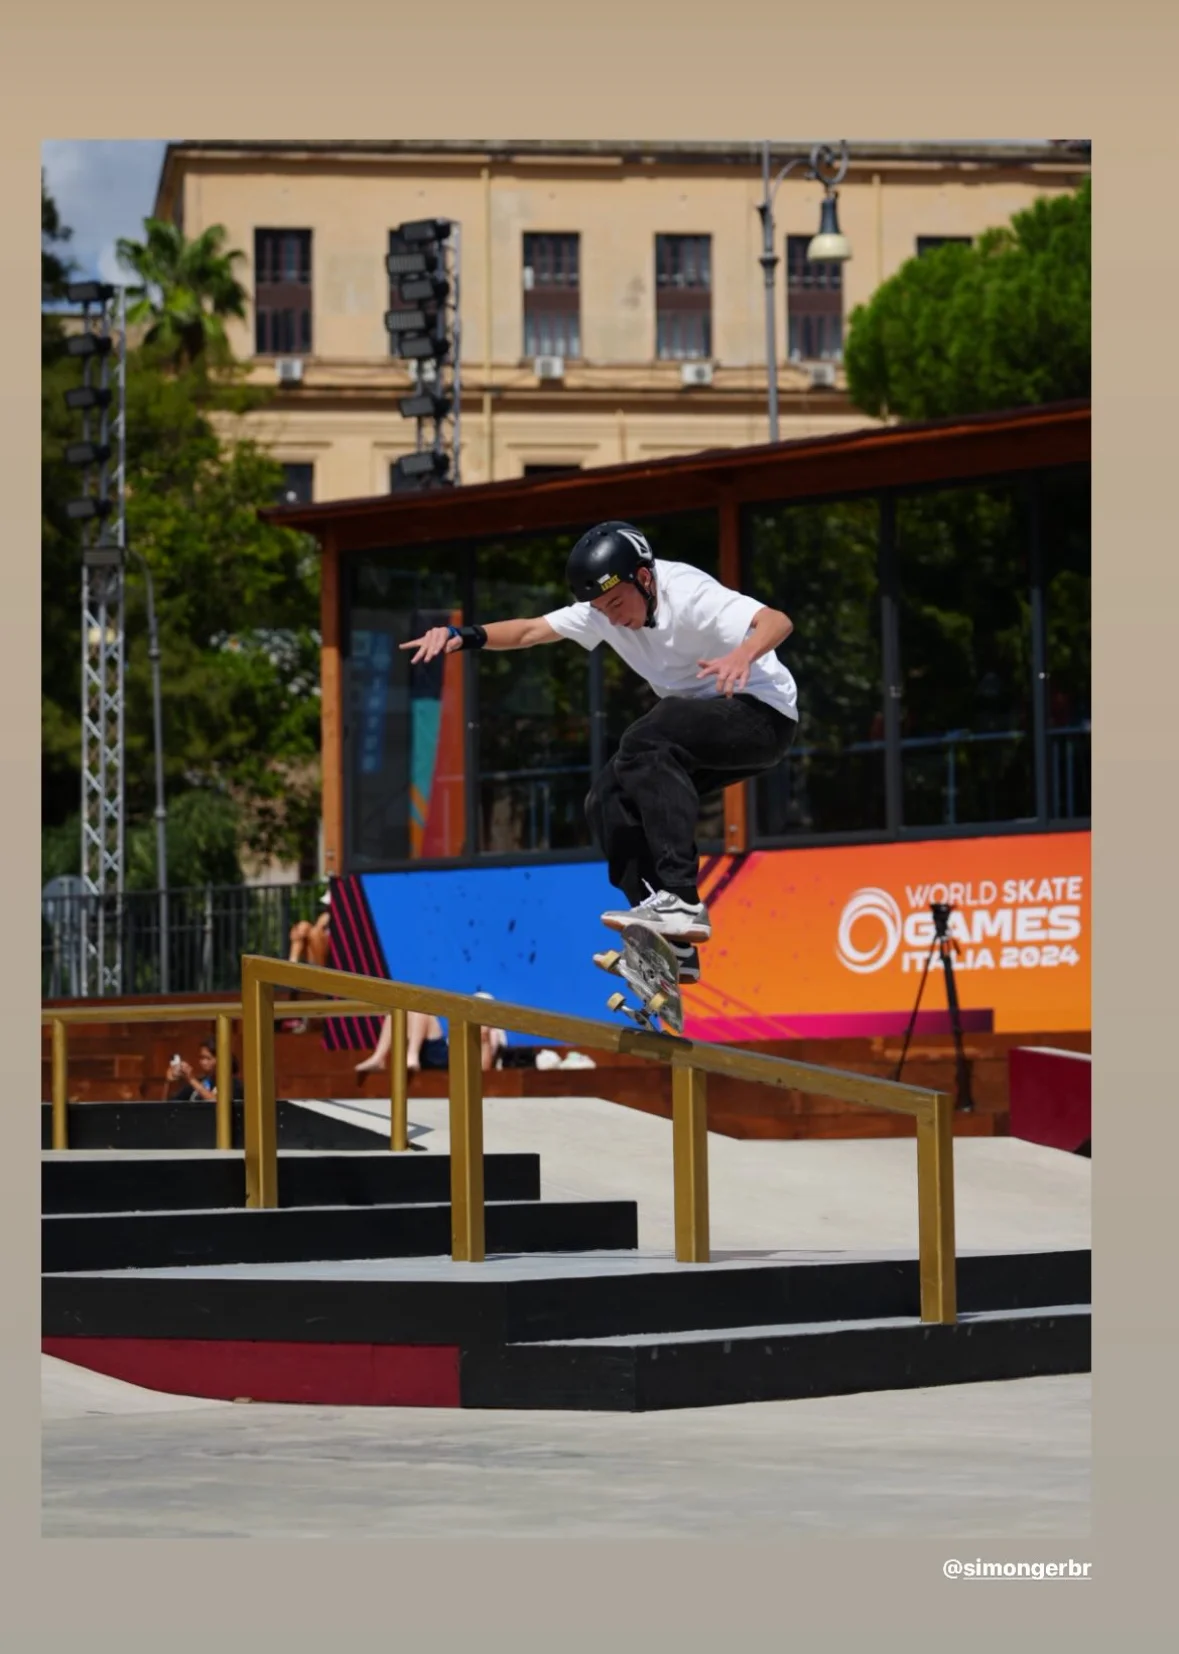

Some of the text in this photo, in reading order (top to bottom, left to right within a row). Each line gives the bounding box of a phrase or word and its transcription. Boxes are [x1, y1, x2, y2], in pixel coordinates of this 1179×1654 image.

[905, 876, 1082, 908] WORLD SKATE
[904, 905, 1081, 946] GAMES
[902, 945, 1080, 973] ITALIA 2024
